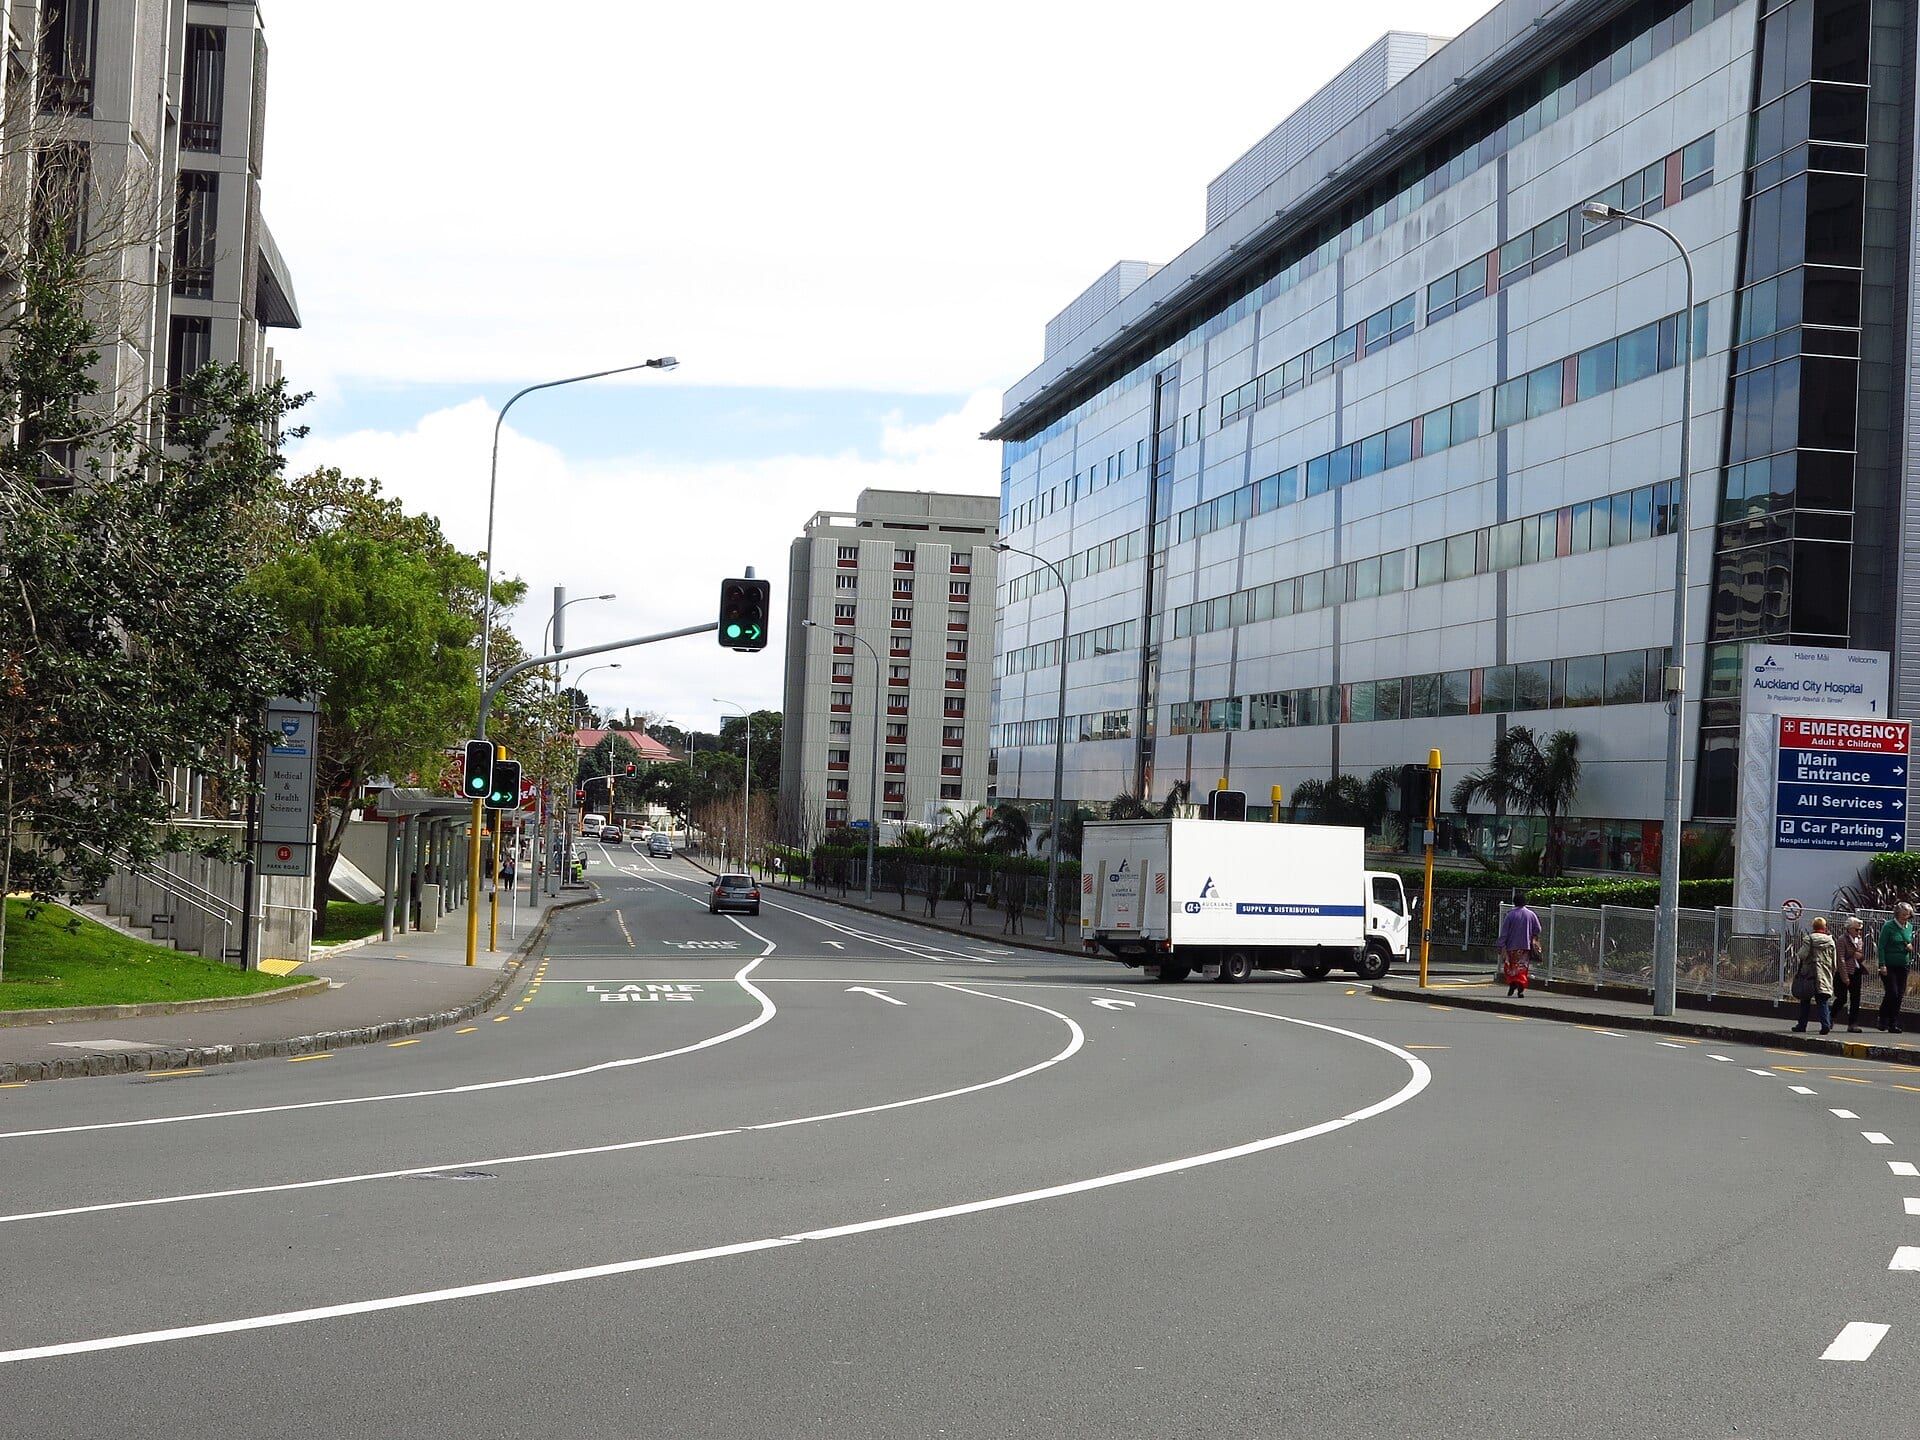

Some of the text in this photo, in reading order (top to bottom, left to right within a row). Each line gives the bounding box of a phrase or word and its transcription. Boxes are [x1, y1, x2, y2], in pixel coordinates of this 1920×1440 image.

[1848, 655, 1878, 664] Welcome
[1753, 678, 1863, 695] Auckland City Hospital
[1870, 699, 1876, 712] 1
[1799, 721, 1906, 740] EMERGENCY
[1811, 738, 1835, 746] Adult
[1847, 739, 1882, 749] Children
[1798, 752, 1837, 766] Main
[273, 771, 302, 780] Medical
[1797, 766, 1870, 782] Entrance
[274, 792, 299, 801] Health
[1797, 794, 1883, 809] All Services
[270, 803, 302, 812] Sciences
[1801, 821, 1827, 834] Car
[1831, 822, 1884, 838] Parking
[1779, 837, 1810, 845] Hospital
[1811, 838, 1838, 846] visitors
[1846, 839, 1874, 847] patients
[1874, 841, 1889, 849] only
[1242, 905, 1266, 913] SUPPLY
[1274, 906, 1320, 914] DISTRIBUTION
[586, 984, 704, 992] LANE
[600, 993, 694, 1002] BUS
